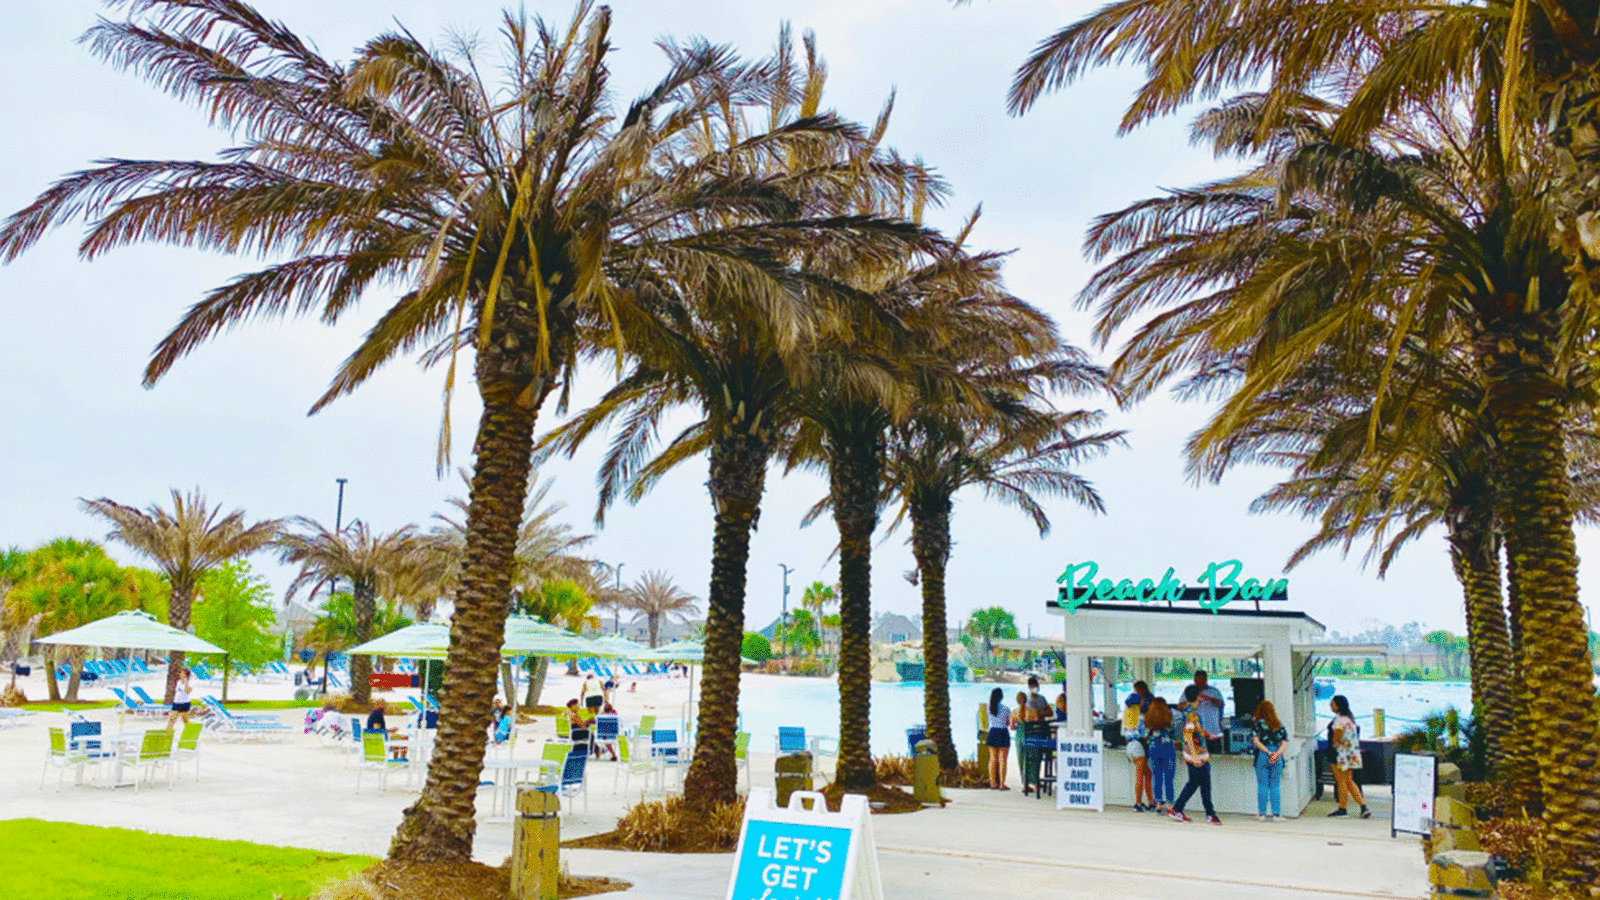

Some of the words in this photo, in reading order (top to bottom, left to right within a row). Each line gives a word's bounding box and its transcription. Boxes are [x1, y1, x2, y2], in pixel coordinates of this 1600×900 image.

[1056, 560, 1187, 614] Beach
[1197, 559, 1289, 615] Bar
[1060, 742, 1072, 752] NO
[1067, 757, 1092, 767] DEBIT
[1070, 769, 1089, 779] AND
[1064, 781, 1096, 792] CREDIT
[1069, 794, 1090, 805] ONLY
[757, 834, 833, 864] LET'S
[761, 863, 818, 891] GET
